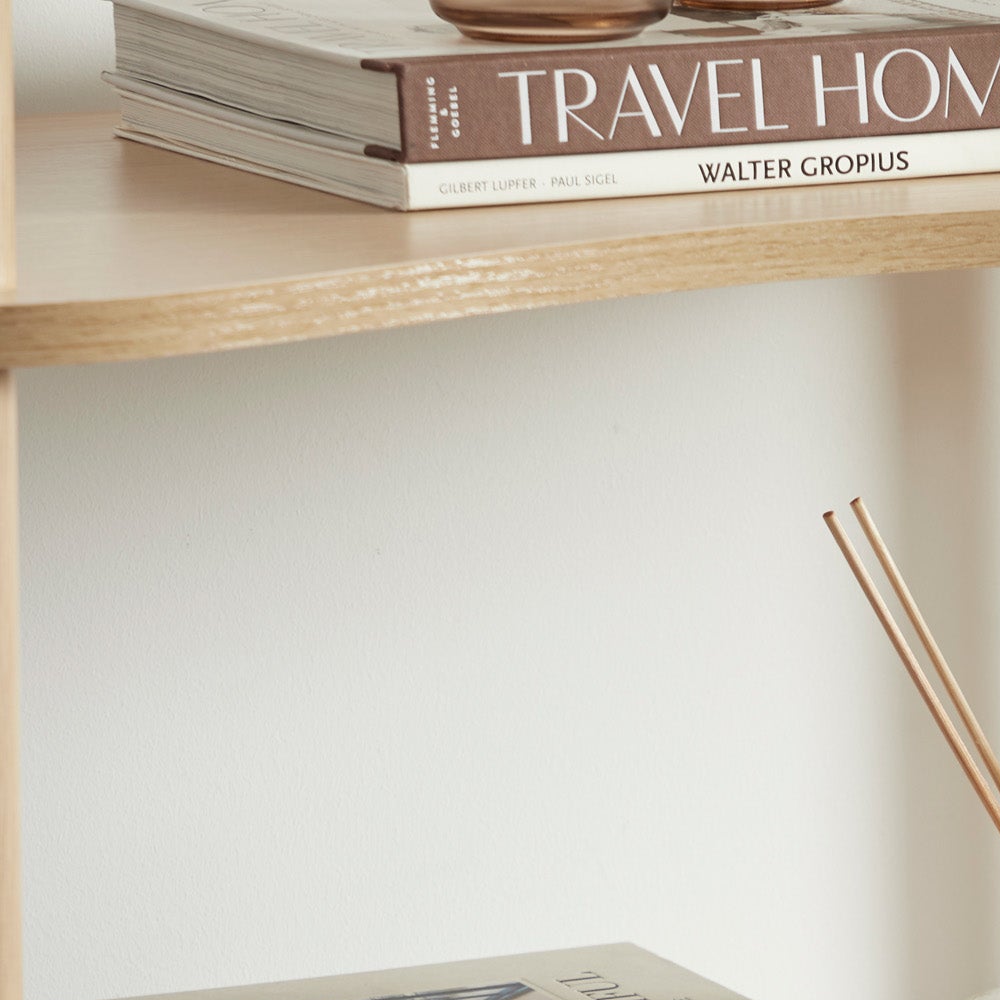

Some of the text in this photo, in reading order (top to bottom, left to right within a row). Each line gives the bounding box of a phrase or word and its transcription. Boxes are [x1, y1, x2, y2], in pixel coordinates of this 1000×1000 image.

[426, 76, 440, 150] FLEMMING
[448, 86, 460, 138] GOEBEL
[498, 58, 789, 145] TRAVEL
[438, 172, 618, 195] GILBERT LUPFER PAUL SIGEL
[697, 151, 910, 184] WALTER GROPIUS
